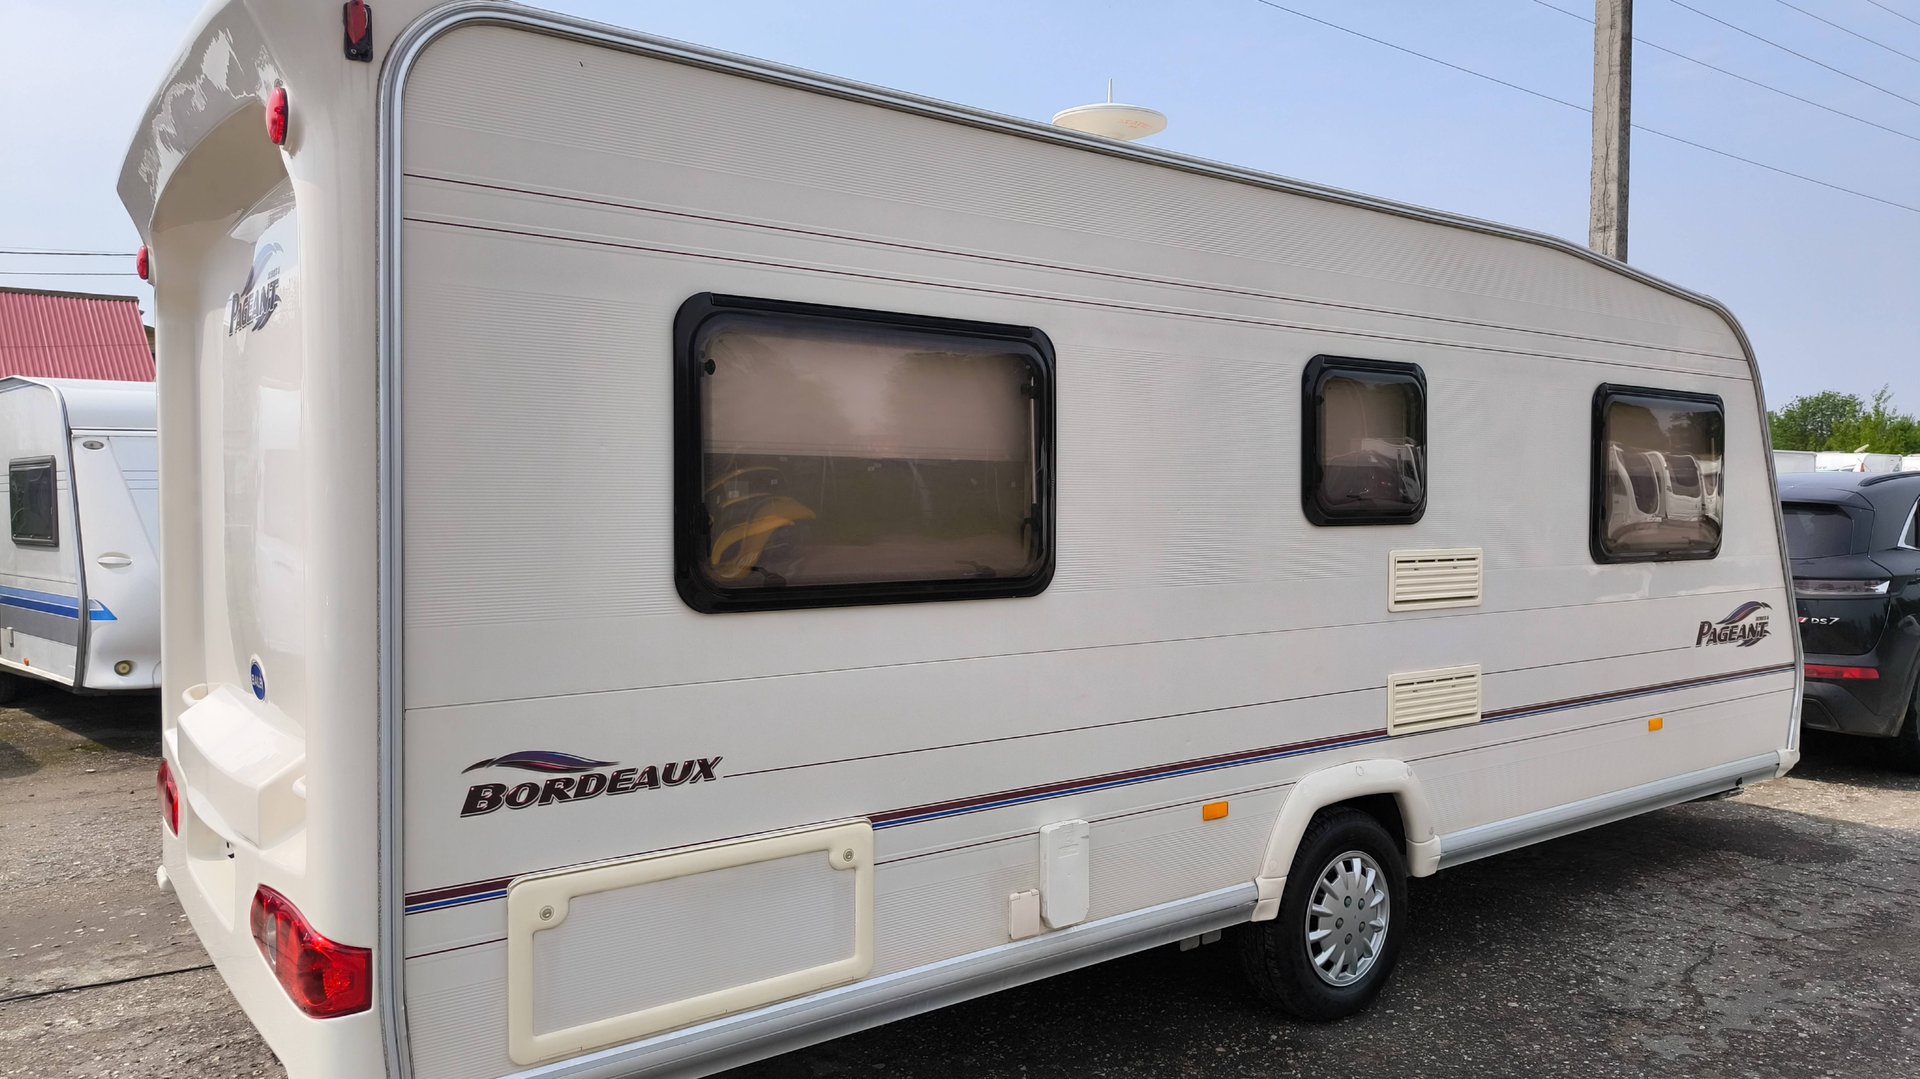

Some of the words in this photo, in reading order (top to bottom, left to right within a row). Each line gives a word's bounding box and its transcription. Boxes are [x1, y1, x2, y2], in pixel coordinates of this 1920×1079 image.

[229, 278, 280, 336] PAGEANT
[1695, 621, 1769, 647] PAGEANT
[460, 756, 723, 818] BORDEAUX
